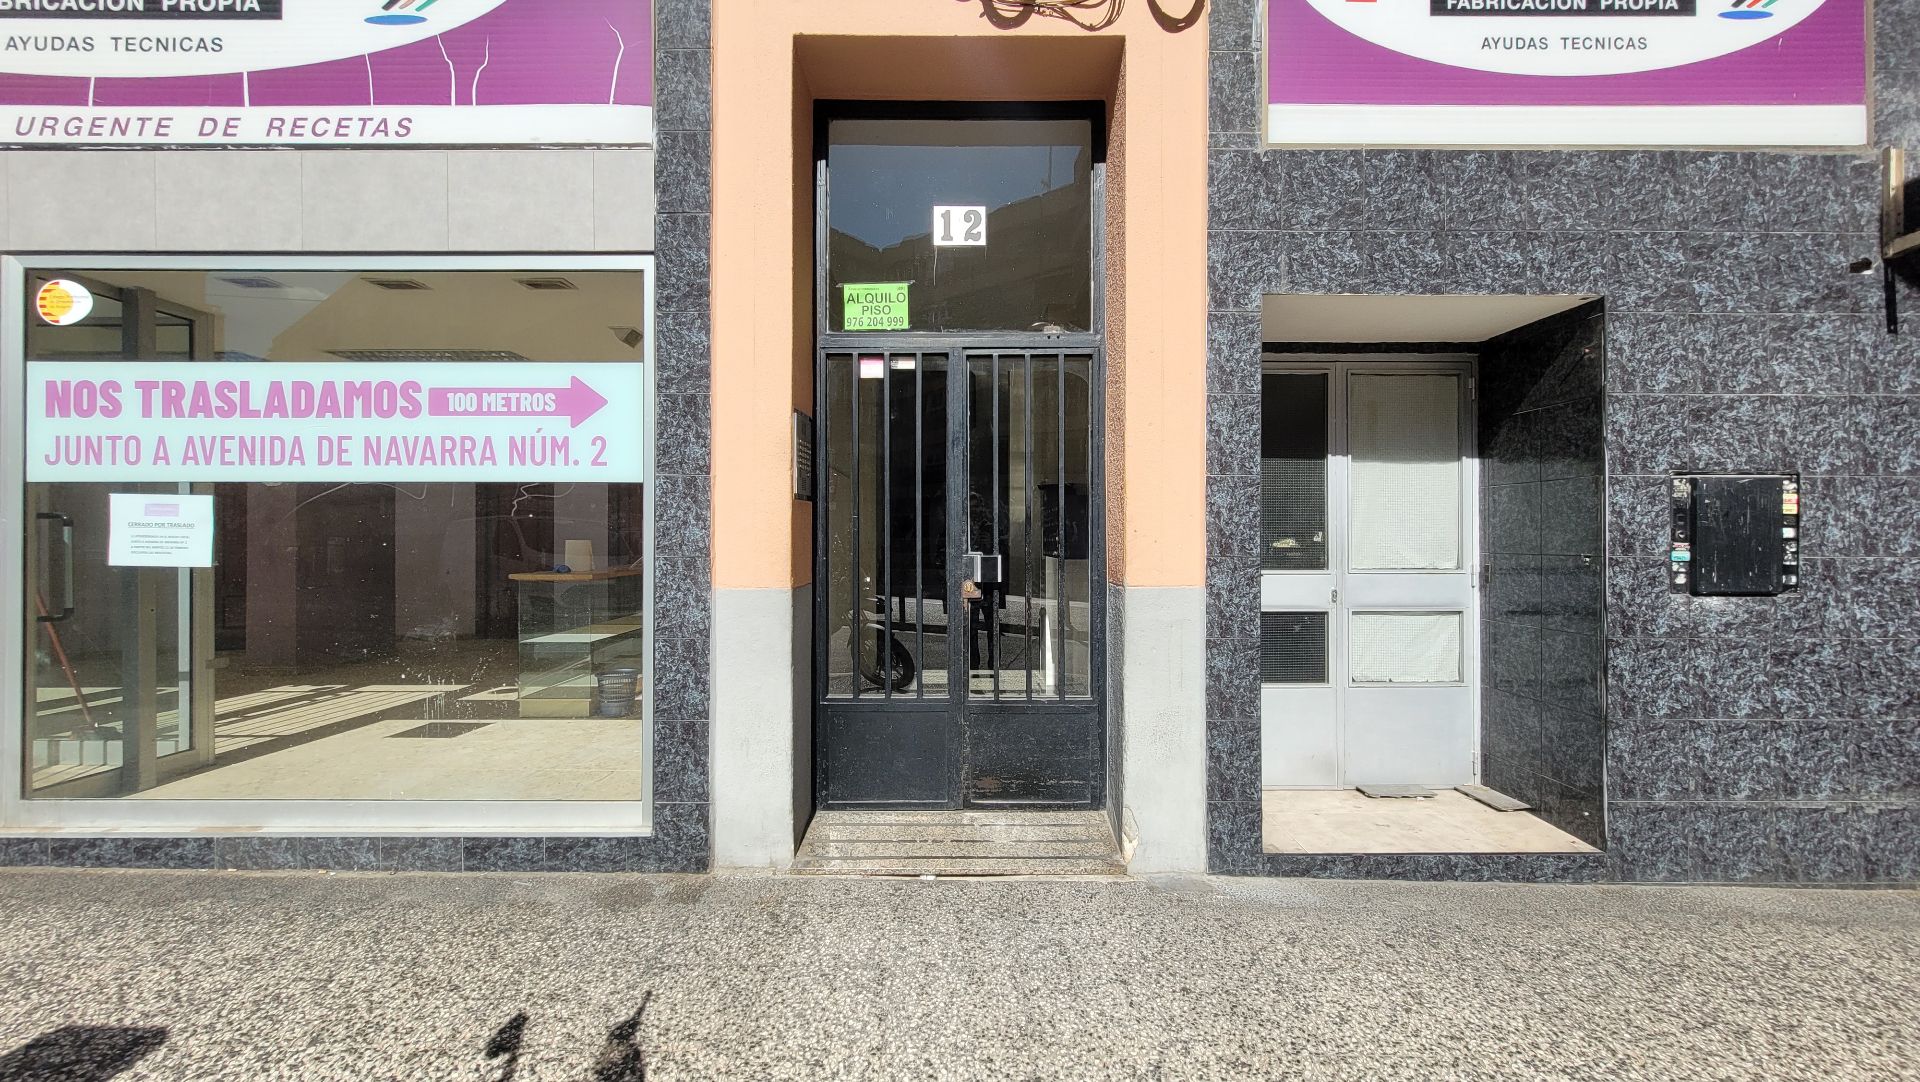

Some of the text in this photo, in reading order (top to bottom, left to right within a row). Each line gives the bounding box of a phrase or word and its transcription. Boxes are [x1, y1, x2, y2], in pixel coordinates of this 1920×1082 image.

[162, 0, 261, 12] PROPIA
[1600, 0, 1679, 10] PROPIA
[5, 36, 224, 53] AYUDAS TECNICAS
[1480, 36, 1648, 51] AYUDAS TECNICAS
[15, 116, 414, 138] URGENTE DE RECETAS
[940, 209, 983, 242] 12
[847, 292, 906, 305] ALQUILO
[862, 304, 892, 315] PISO
[847, 316, 904, 327] 976 204 999
[45, 379, 423, 419] NOS TRASLADAMOS
[446, 392, 556, 412] 100 METROS
[44, 428, 608, 467] JUNTO A AVENIDA DE NAVARRA NÚM. 2
